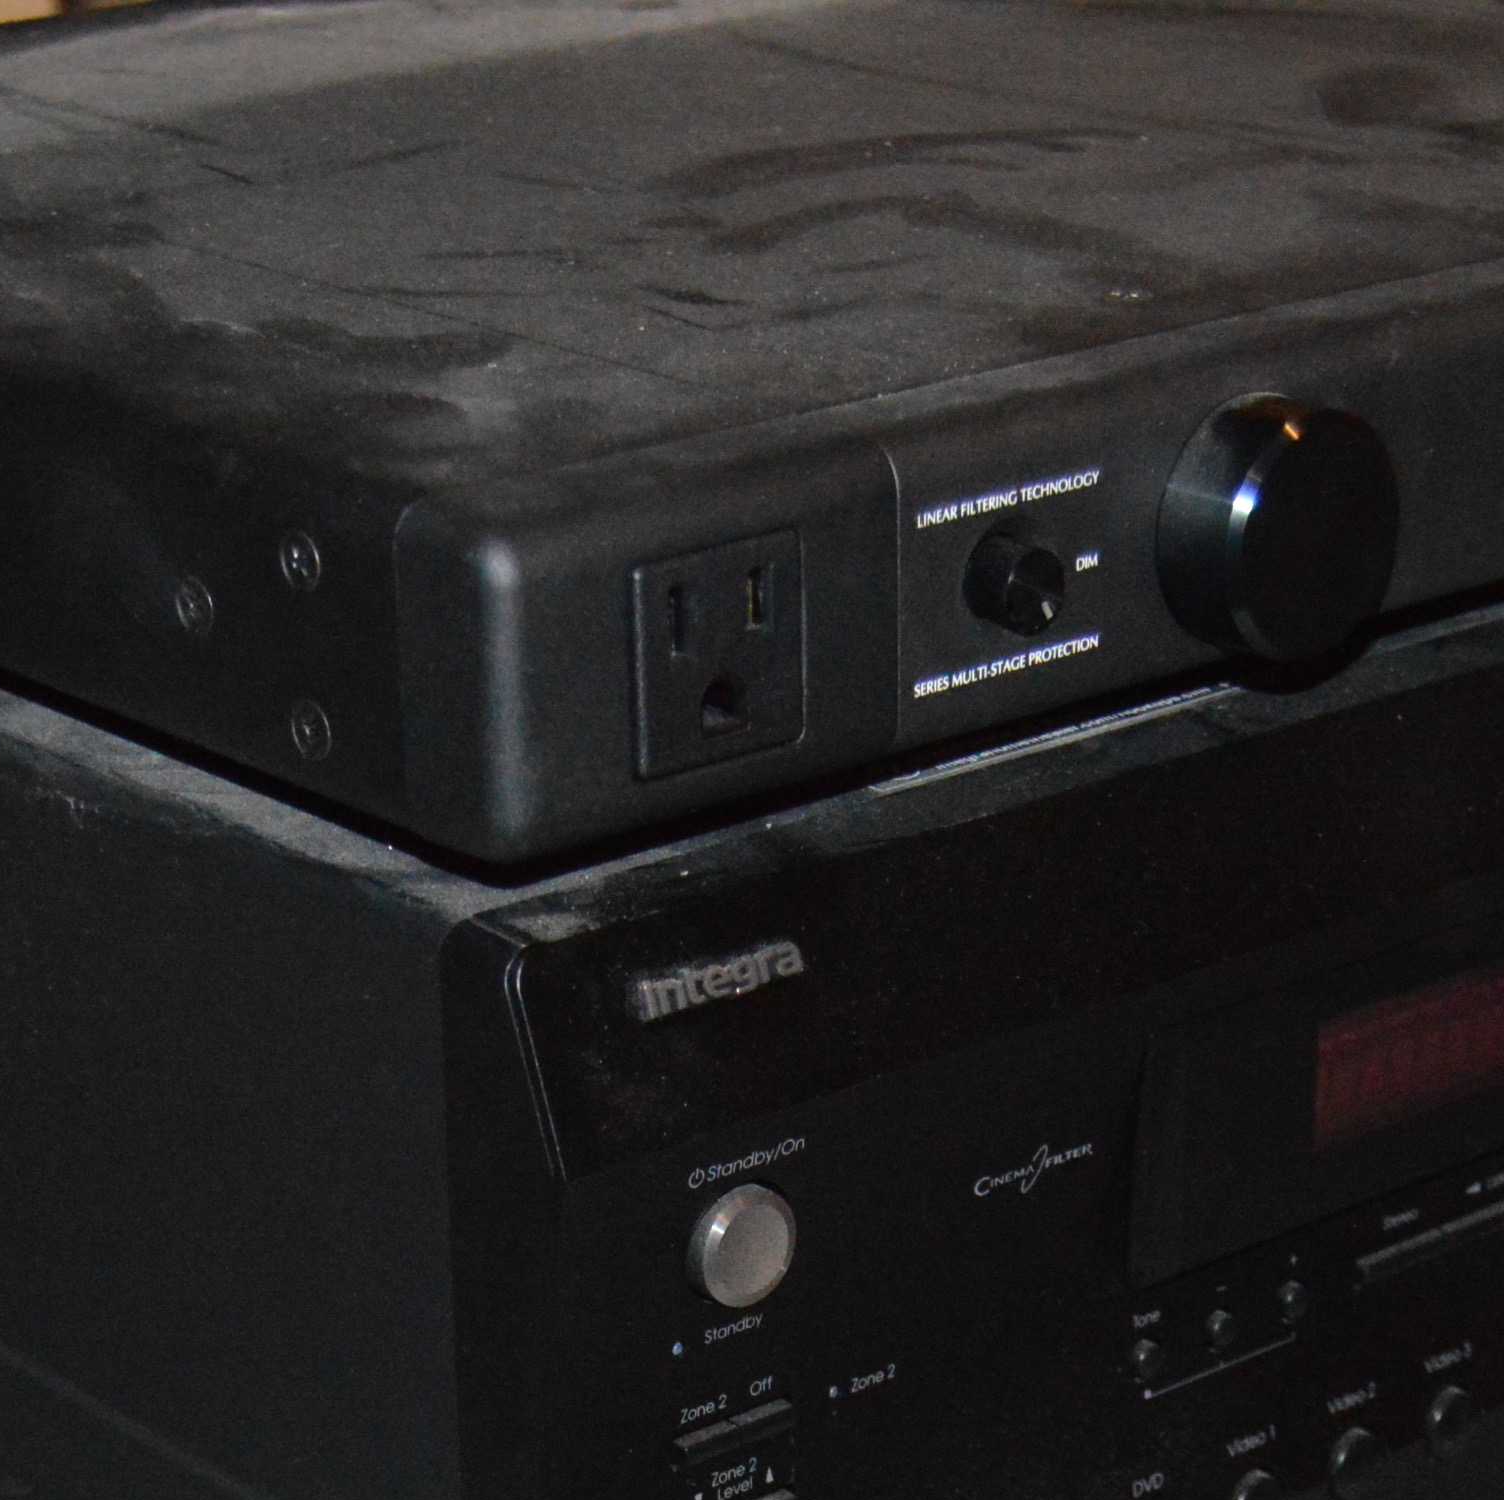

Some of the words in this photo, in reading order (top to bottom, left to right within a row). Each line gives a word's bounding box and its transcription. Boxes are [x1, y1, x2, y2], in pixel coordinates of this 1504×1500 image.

[916, 505, 959, 530] LINEAR
[960, 490, 1018, 518] FILTERING
[1020, 468, 1101, 503] TECHNOLOGY
[1075, 552, 1100, 573] DIM
[913, 674, 951, 700] SERIES
[951, 653, 1027, 689] MULTI-STAGE
[1028, 633, 1101, 668] PROTECTION
[706, 1135, 806, 1182] Standby/On
[703, 1313, 764, 1345] Standby
[749, 1375, 773, 1397] Off
[850, 1369, 885, 1394] Zone
[886, 1362, 896, 1380] 2
[680, 1401, 715, 1425] Zone
[718, 1393, 728, 1411] 2
[710, 1464, 746, 1488] Zone
[748, 1457, 758, 1474] 2
[1131, 1471, 1165, 1499] DVD
